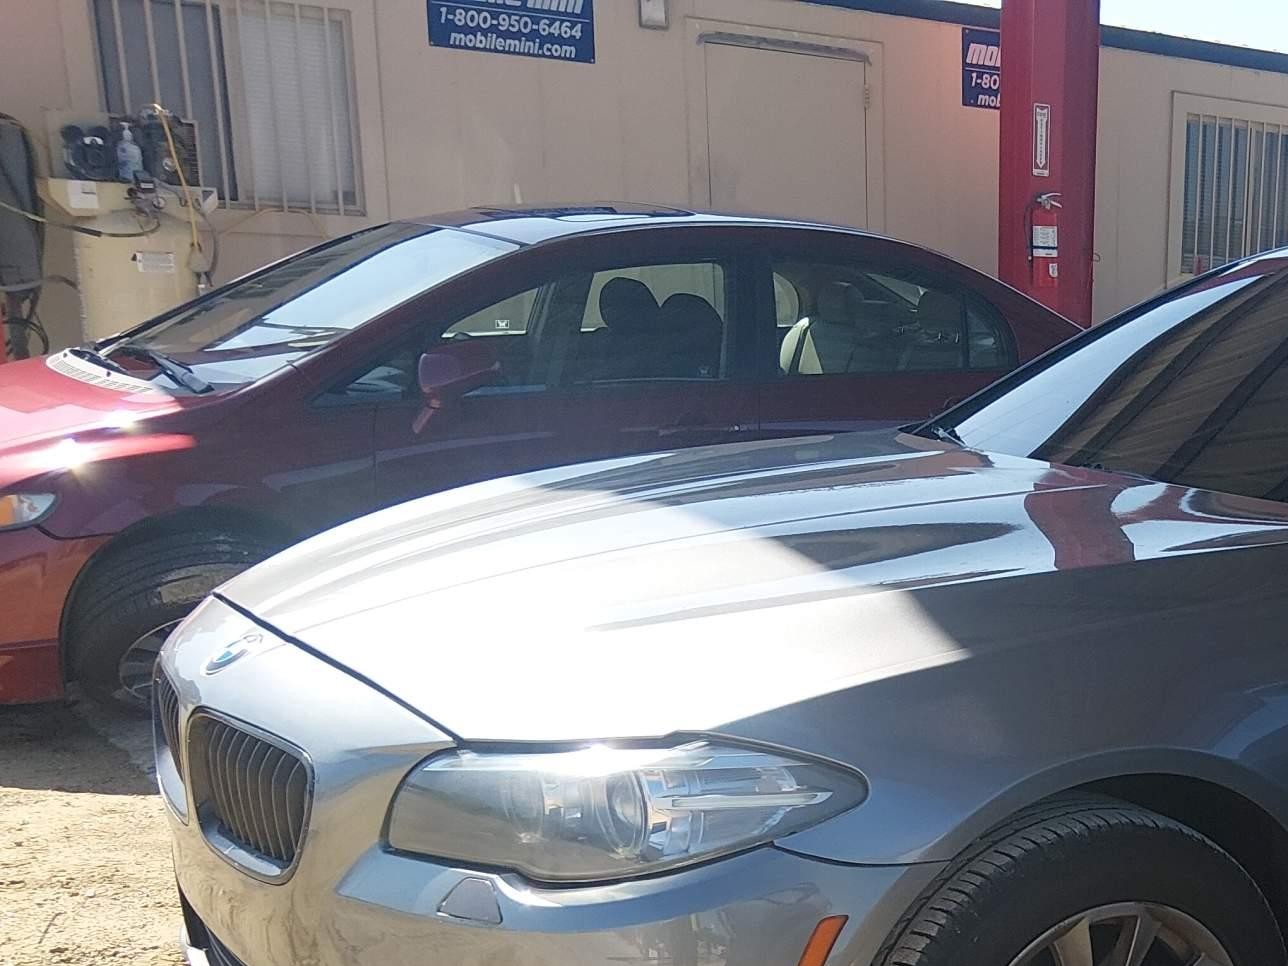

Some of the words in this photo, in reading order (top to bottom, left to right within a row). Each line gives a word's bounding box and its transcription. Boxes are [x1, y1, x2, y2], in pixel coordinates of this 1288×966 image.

[439, 6, 582, 40] 1-800-950-6464
[450, 31, 576, 59] mobilemini.com
[966, 42, 1000, 67] mo
